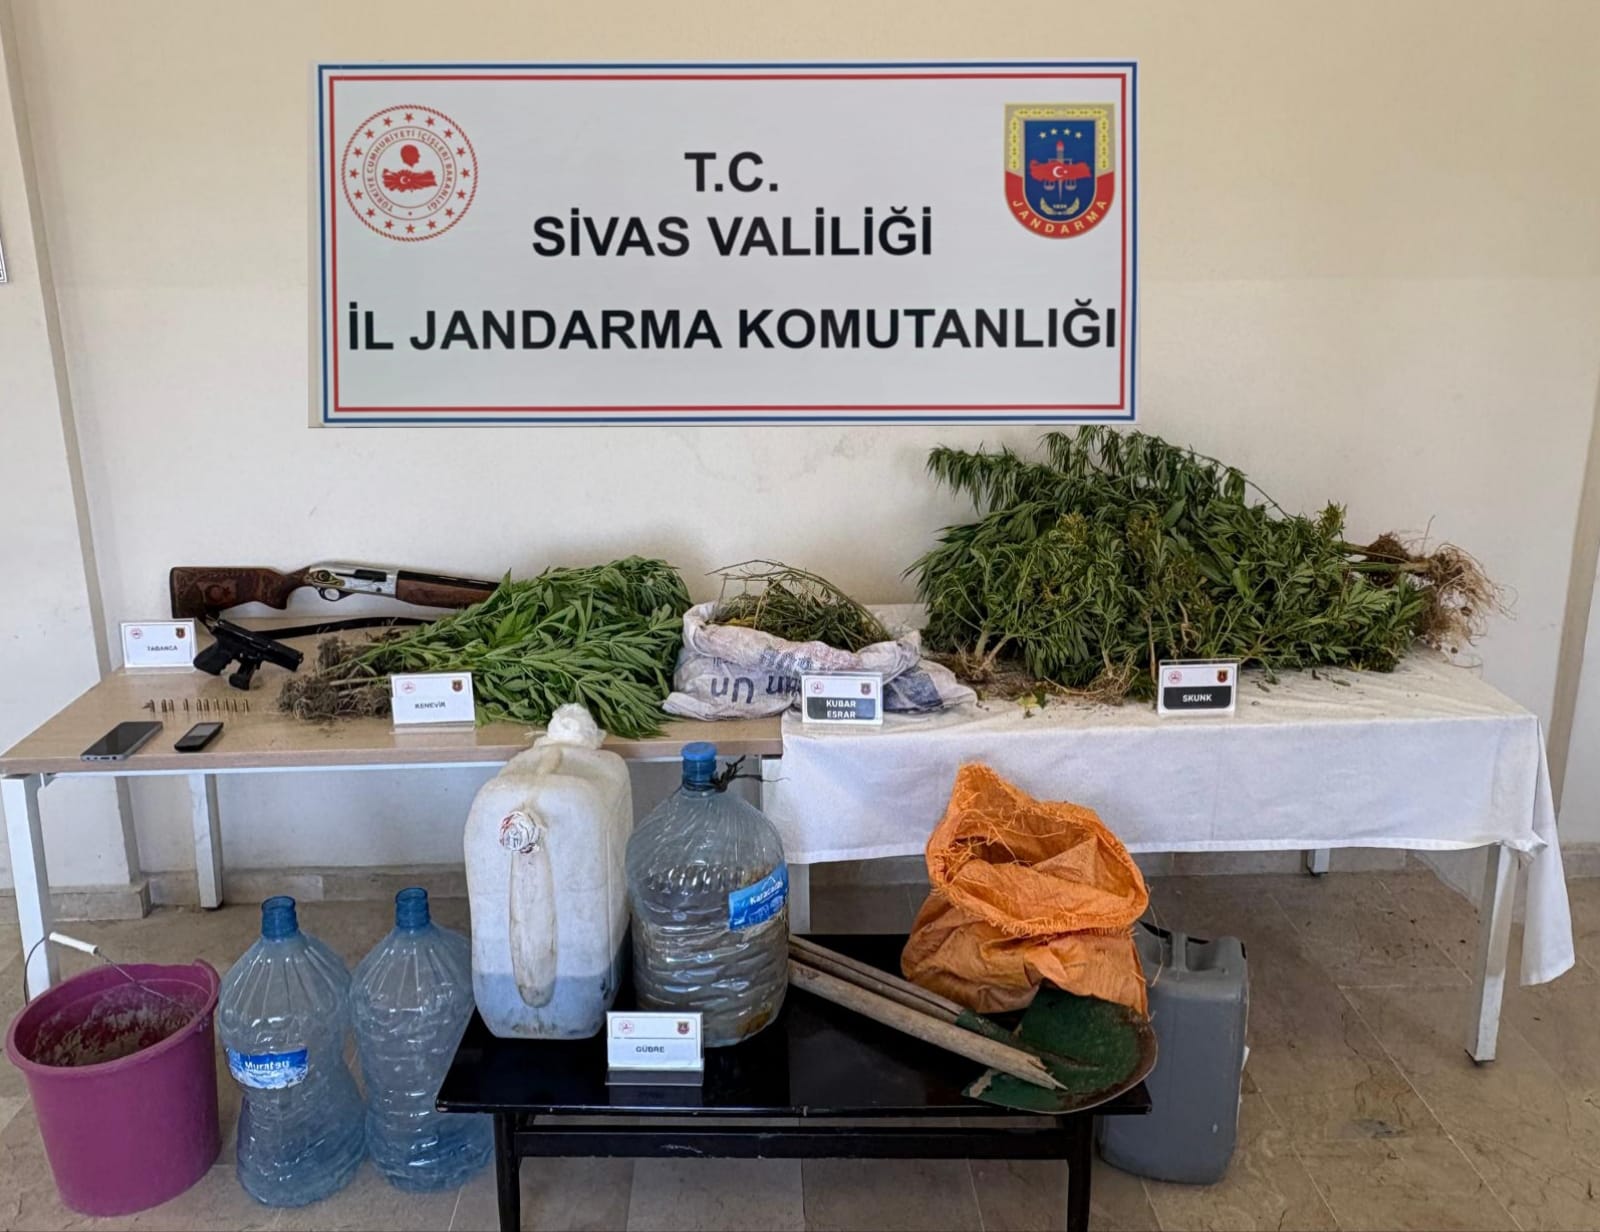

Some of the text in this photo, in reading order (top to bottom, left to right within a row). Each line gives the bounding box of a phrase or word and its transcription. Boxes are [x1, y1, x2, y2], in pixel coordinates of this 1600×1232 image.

[367, 130, 454, 212] TÜRKİYE CUMHURİYETİ İÇİŞLERİ BAKANLIĞI
[684, 152, 778, 193] T.C.
[532, 206, 931, 257] SİVAS VALİLİĞİ
[1012, 199, 1108, 234] JANDARMA
[349, 298, 1116, 350] İL JANDARMA KOMUTANLIĞI
[826, 699, 857, 708] KUBAR
[826, 710, 857, 719] ESRAR
[1182, 693, 1212, 703] SKUNK
[635, 1045, 665, 1053] GÜBRE
